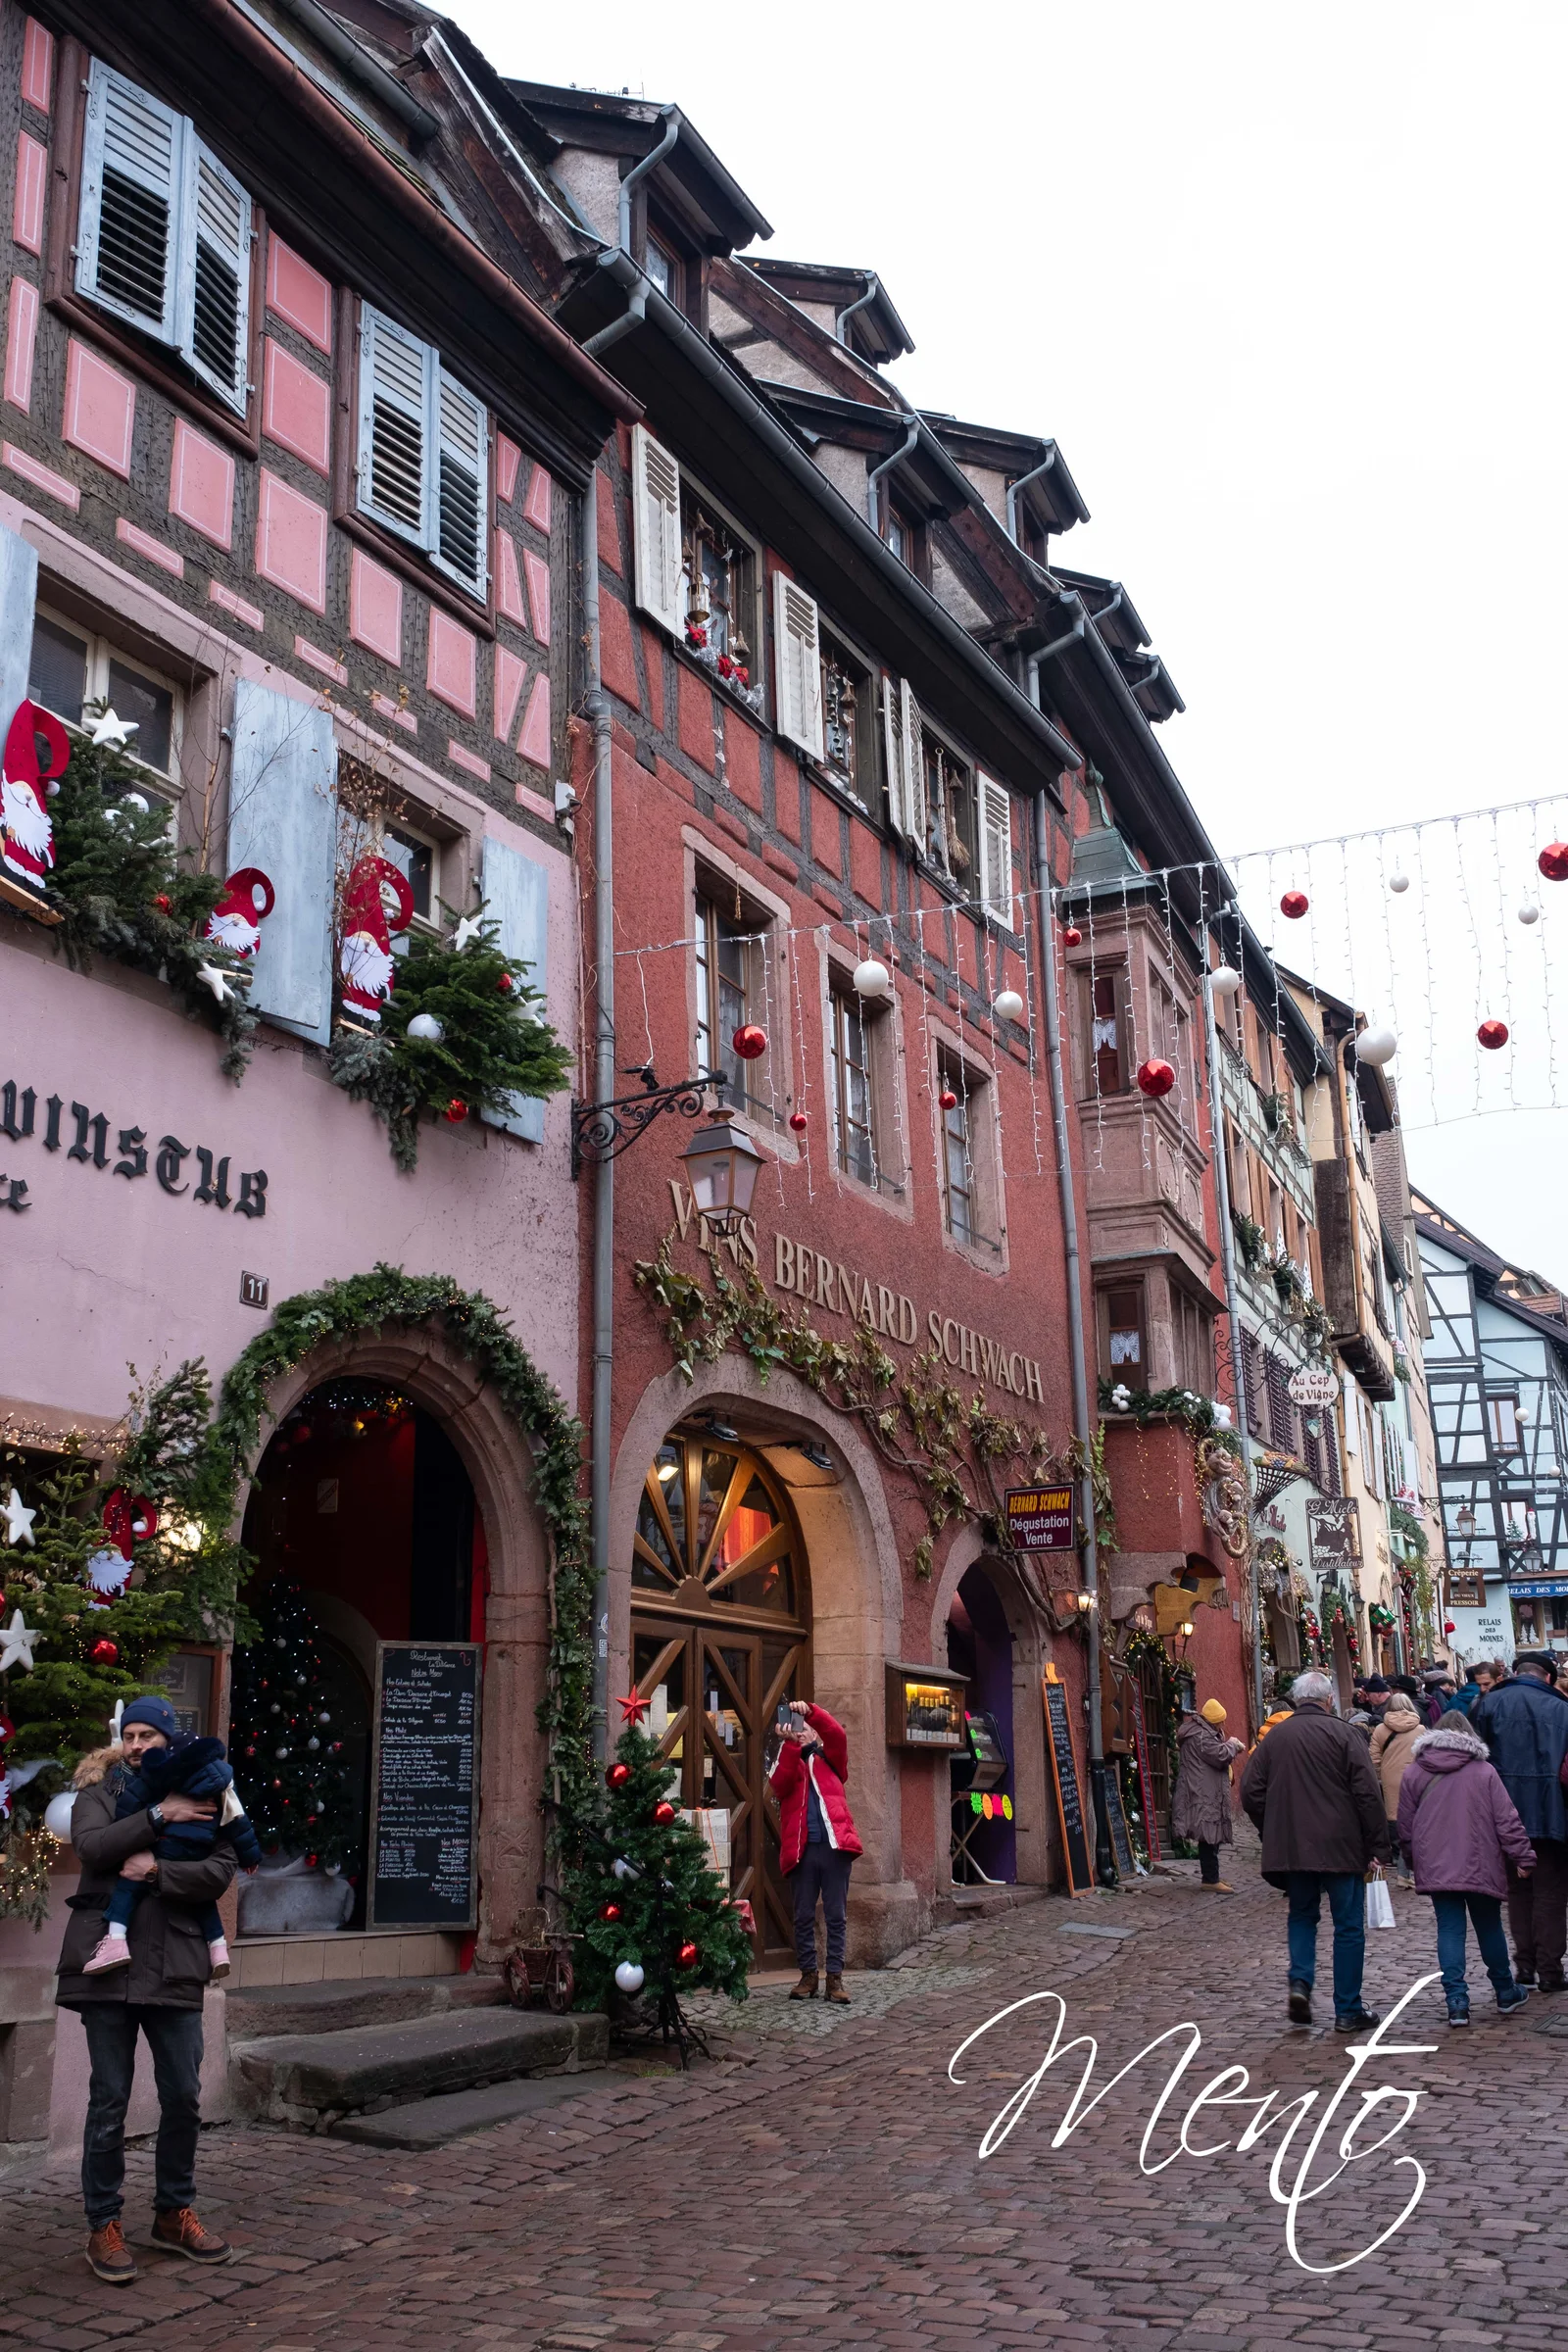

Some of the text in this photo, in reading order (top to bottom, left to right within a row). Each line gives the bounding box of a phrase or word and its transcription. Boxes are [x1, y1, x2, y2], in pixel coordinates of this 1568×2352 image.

[248, 1278, 264, 1301] 11
[773, 1232, 918, 1346] BERNARD
[928, 1309, 1046, 1405] SCHWACH
[1292, 1374, 1329, 1387] Au Cep
[1294, 1389, 1335, 1401] de Vigne
[1009, 1492, 1070, 1514] BERNARD SCHWACH
[1009, 1515, 1069, 1533] Dégustation
[1025, 1532, 1054, 1545] Vente
